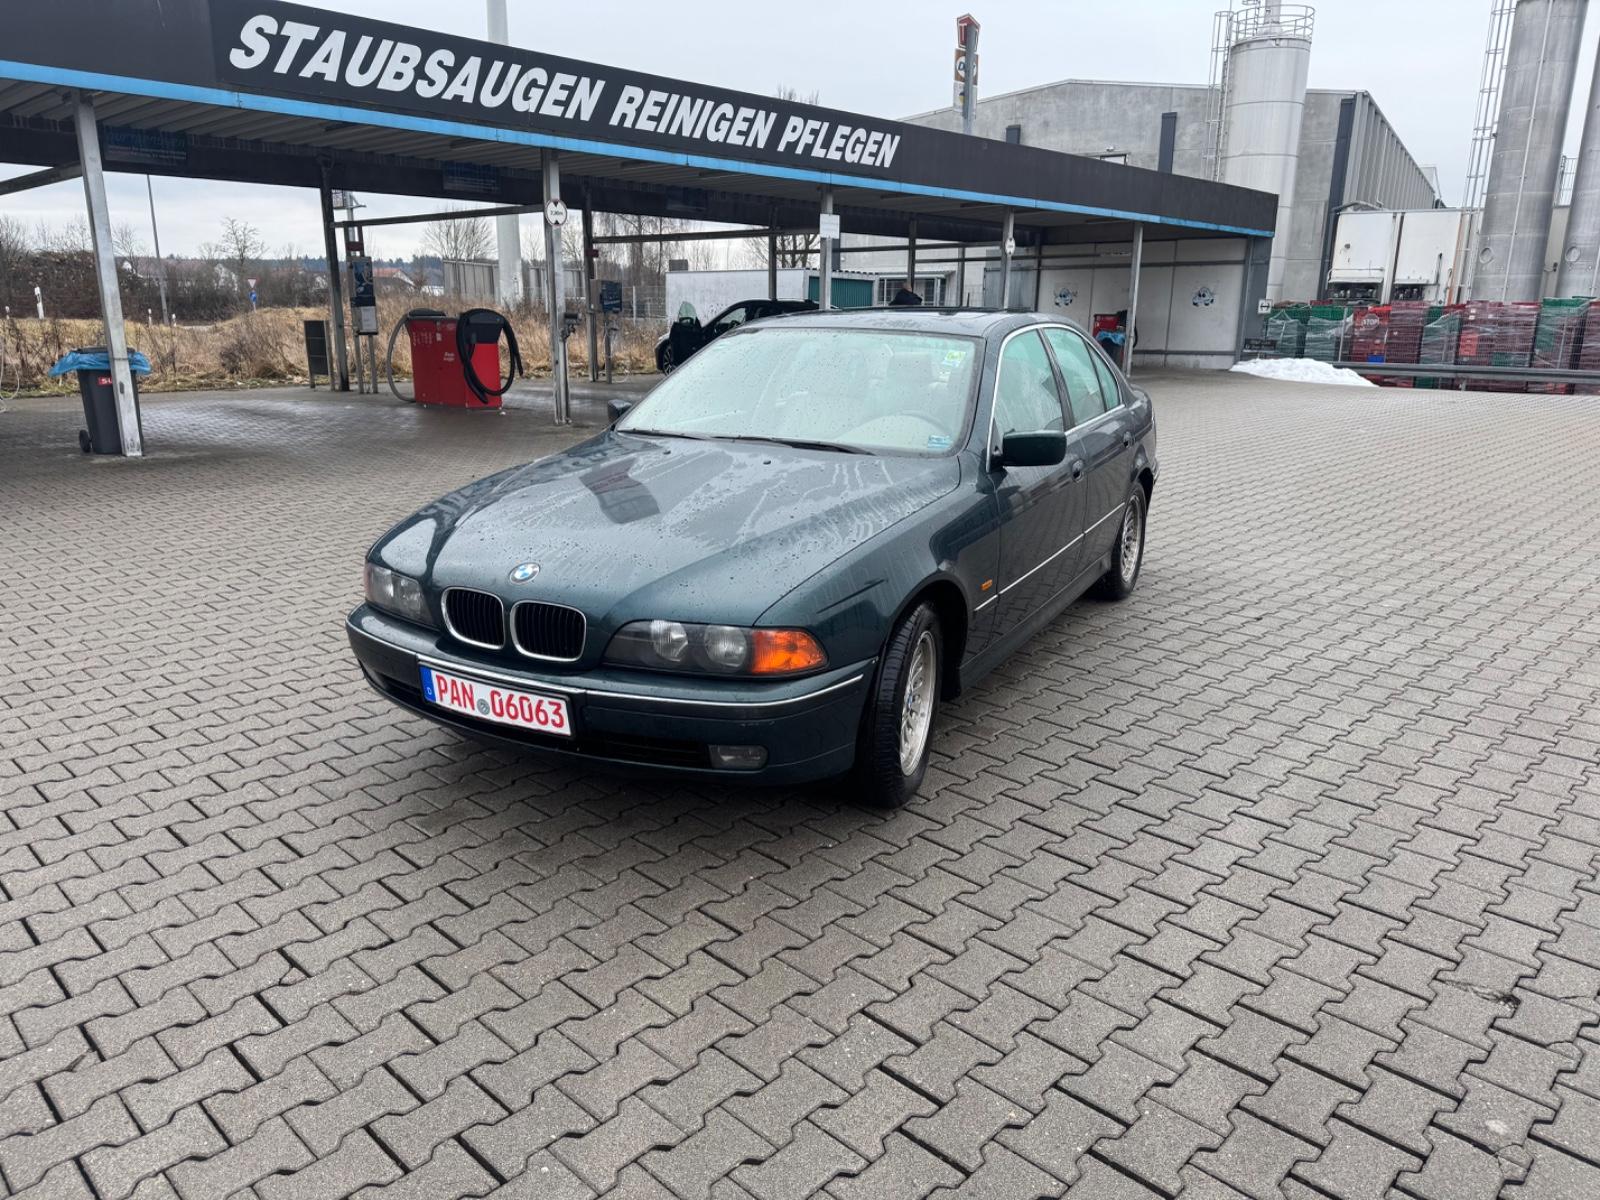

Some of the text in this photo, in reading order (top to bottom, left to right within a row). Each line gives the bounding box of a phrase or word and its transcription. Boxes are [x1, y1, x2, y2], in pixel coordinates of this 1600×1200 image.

[229, 14, 901, 168] STAUBSAUGEN REINIGEN PFLEGEN
[1363, 318, 1378, 326] STOP
[435, 674, 564, 728] PAN 06063
